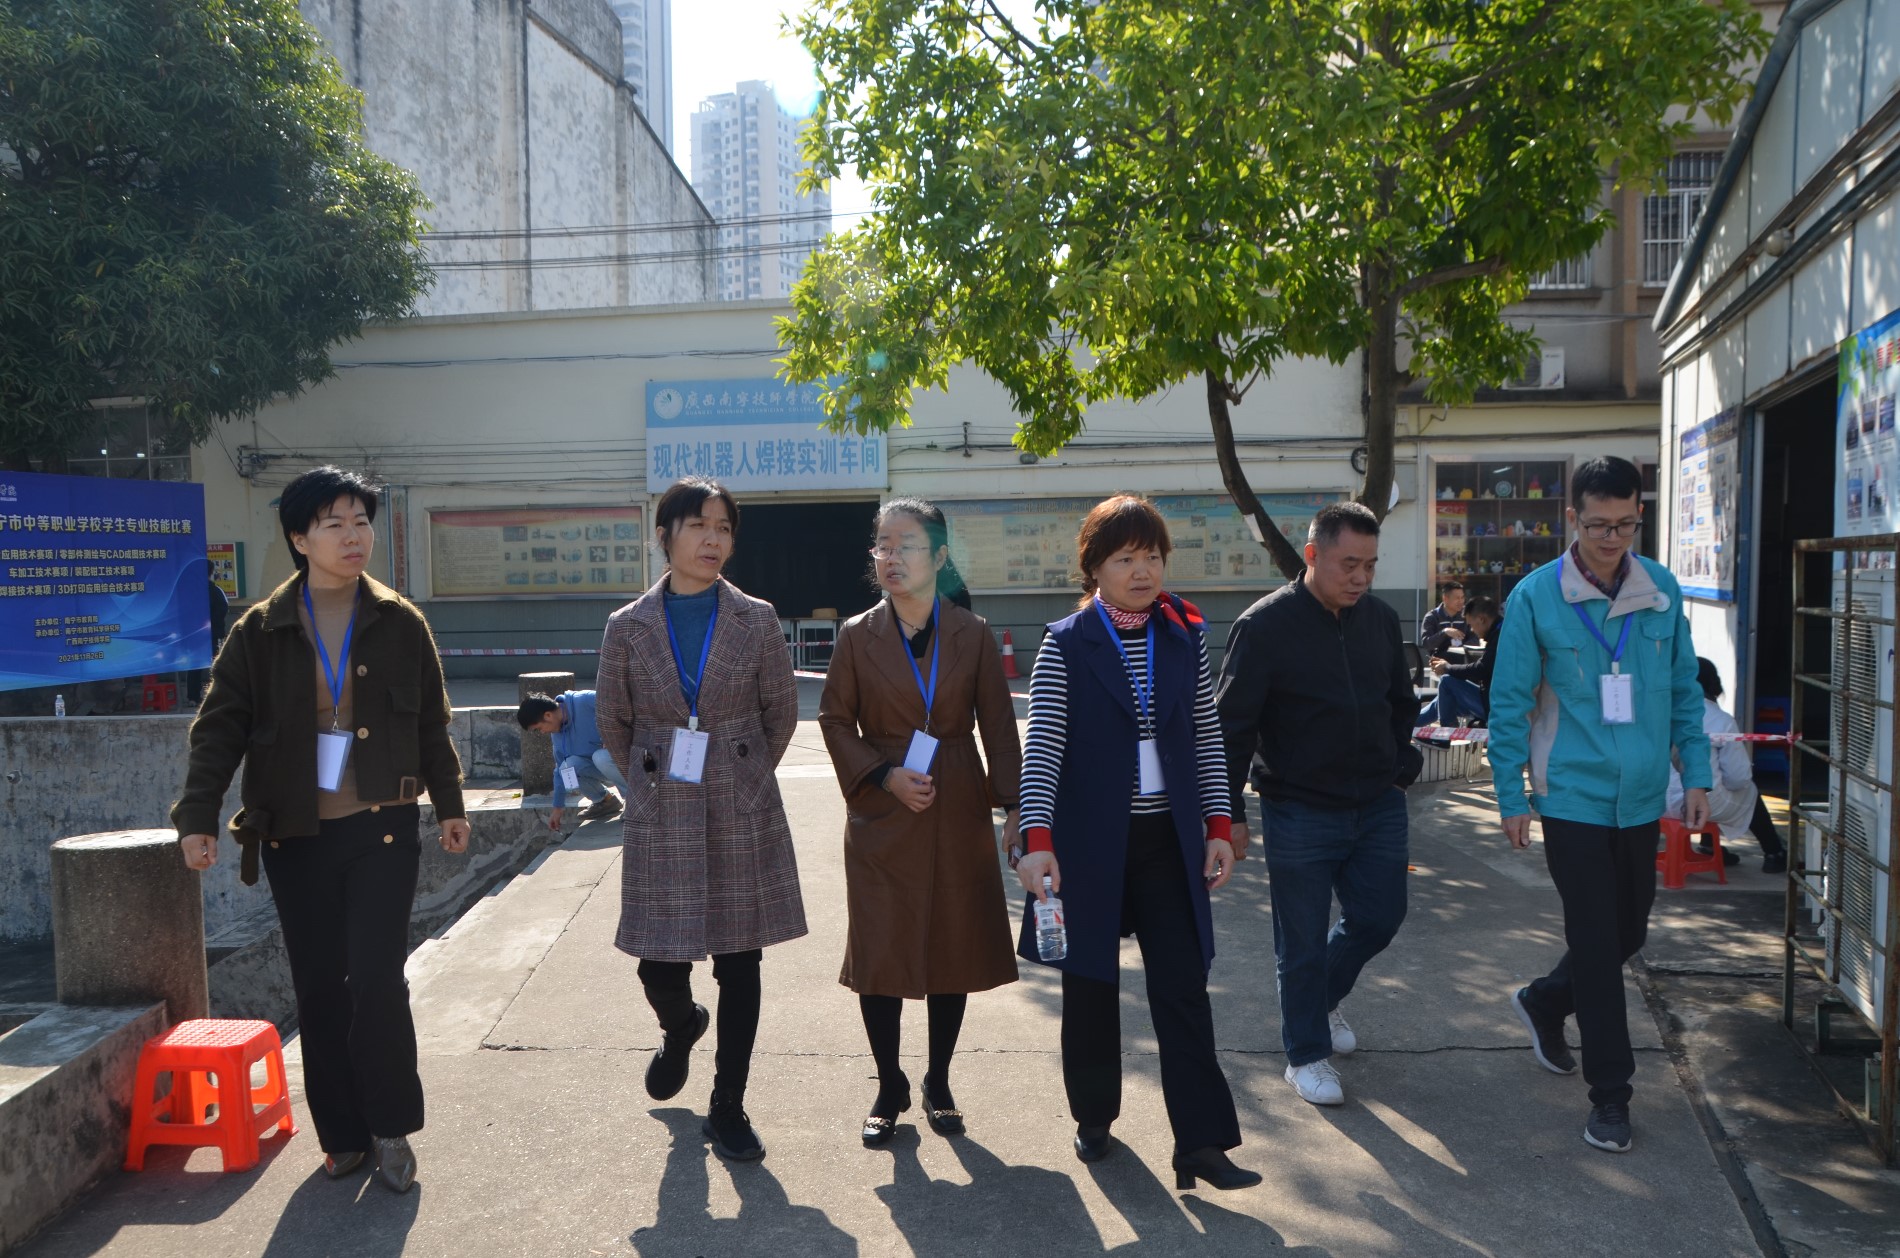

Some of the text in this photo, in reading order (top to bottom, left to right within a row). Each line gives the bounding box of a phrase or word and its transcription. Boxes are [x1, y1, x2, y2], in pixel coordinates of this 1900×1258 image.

[653, 438, 880, 478] 现代机器人焊接实训车间
[0, 514, 192, 533] 宁市中等职业学校学生专业技能比赛
